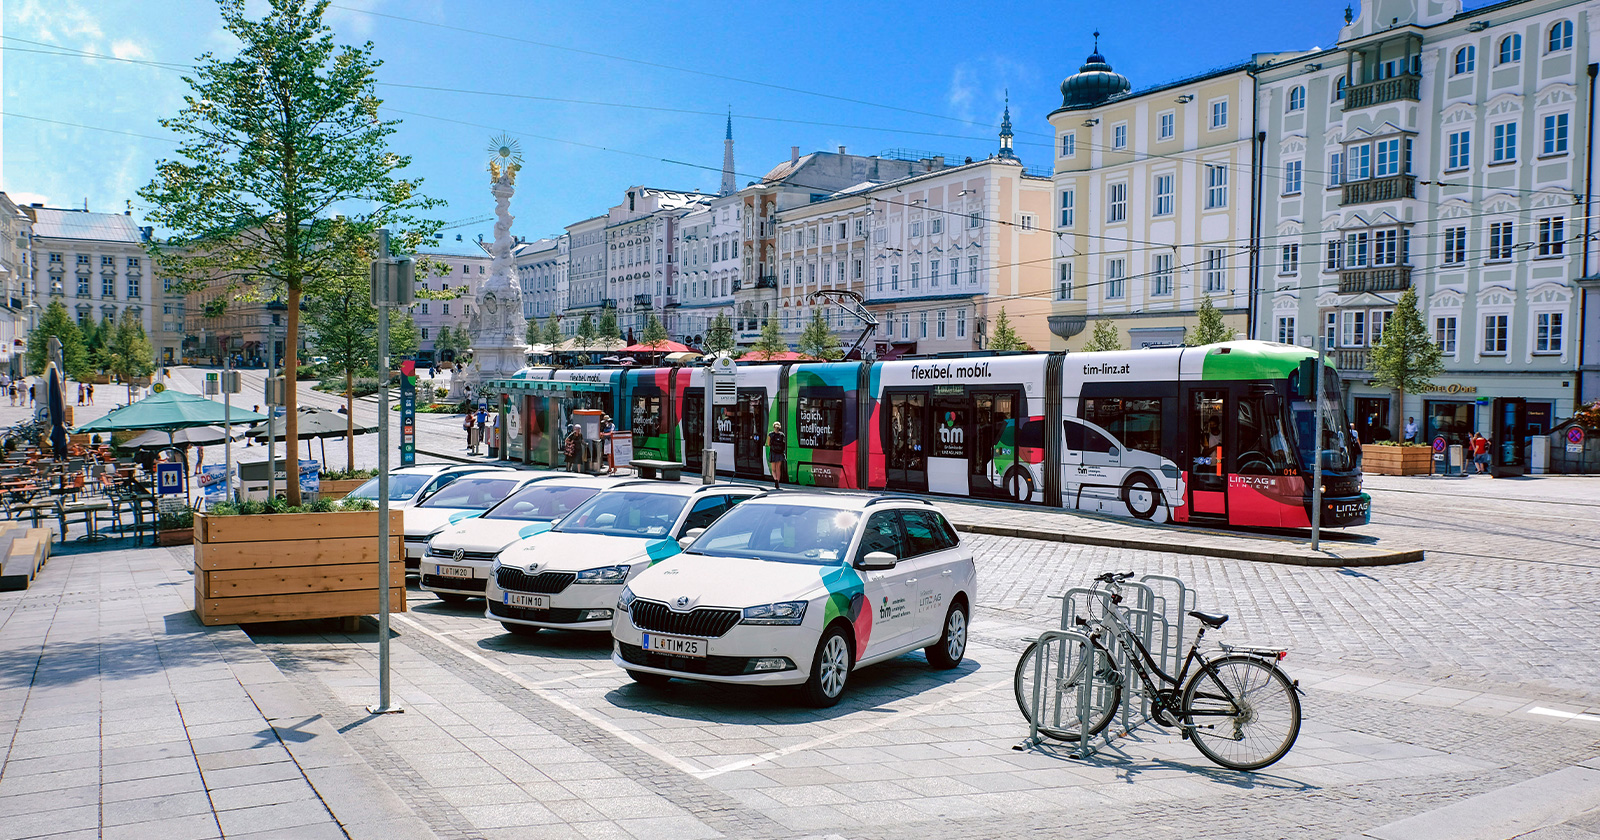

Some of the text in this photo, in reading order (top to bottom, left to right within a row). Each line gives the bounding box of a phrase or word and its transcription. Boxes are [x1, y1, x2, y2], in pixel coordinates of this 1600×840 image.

[911, 362, 992, 380] flexibel. mobil.
[1083, 363, 1130, 375] tim-linz.at
[800, 410, 822, 422] täglich.
[800, 422, 832, 436] intelligent.
[939, 423, 964, 444] tim
[800, 436, 818, 446] mobil.
[1336, 504, 1357, 512] LINZ
[933, 594, 942, 602] AG
[880, 605, 891, 619] tim
